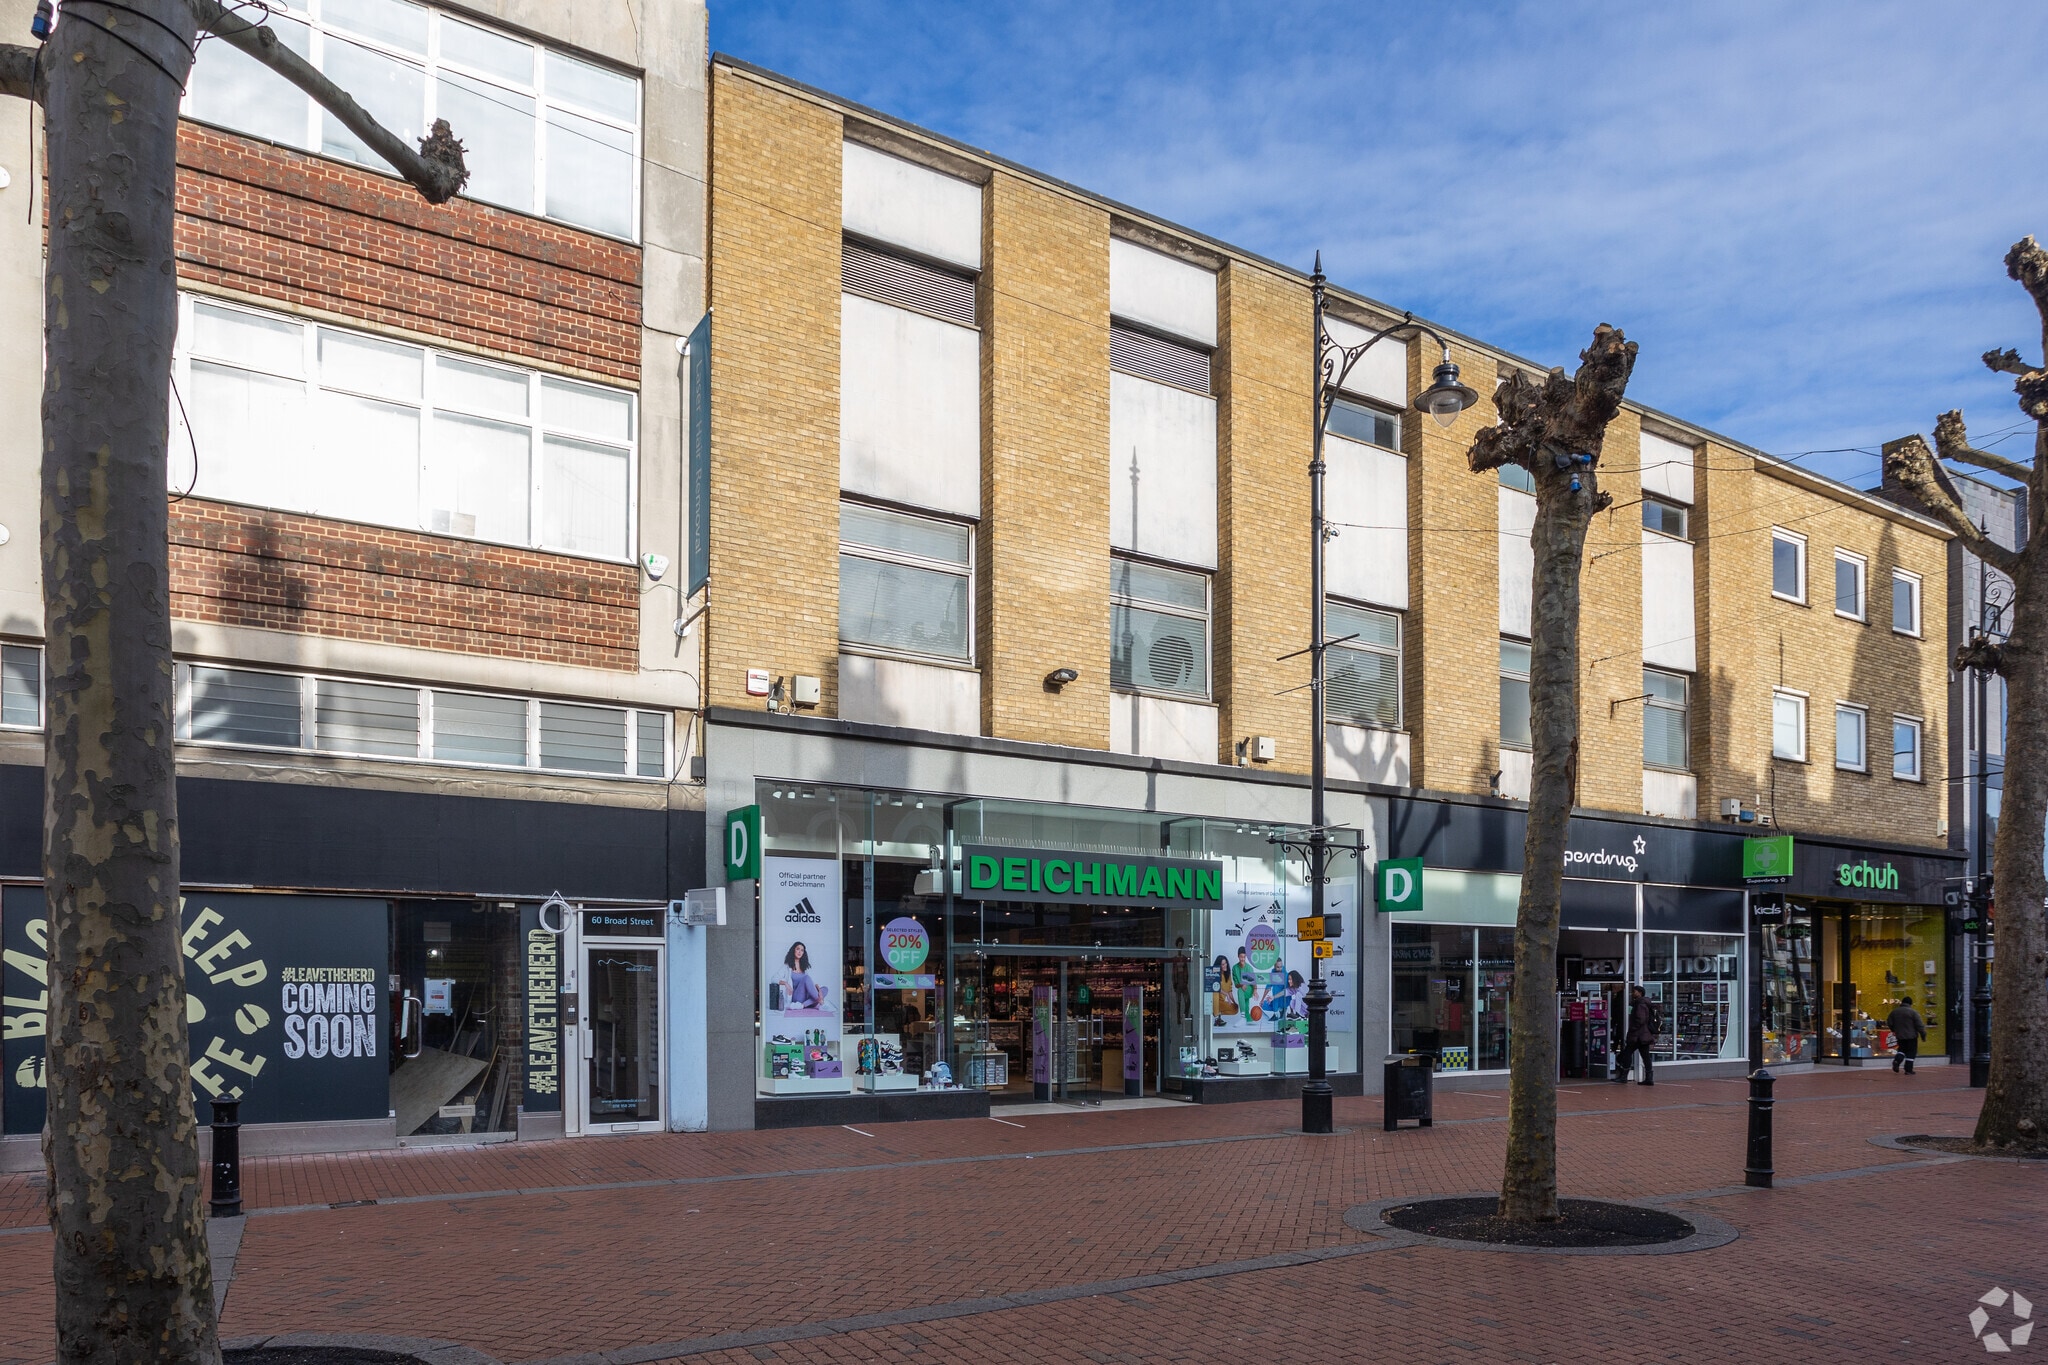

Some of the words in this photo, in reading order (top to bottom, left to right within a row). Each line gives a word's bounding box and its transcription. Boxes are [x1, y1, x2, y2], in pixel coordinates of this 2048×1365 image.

[695, 419, 703, 459] Hair
[731, 820, 748, 868] D
[1564, 848, 1639, 873] perdrug
[778, 871, 802, 880] Official
[802, 872, 826, 881] partner
[969, 855, 1222, 900] DEICHMANN
[1839, 860, 1899, 890] schuh
[788, 880, 826, 889] Deichmann
[1385, 867, 1413, 903] D
[1753, 903, 1782, 915] kids
[591, 916, 602, 925] 60
[604, 916, 628, 926] Broad
[630, 917, 654, 926] Street
[784, 912, 822, 923] adidas
[1306, 920, 1315, 929] NO
[887, 934, 923, 949] 20%
[1250, 938, 1275, 951] 20%
[887, 949, 921, 964] OFF
[1250, 951, 1274, 964] OFF
[281, 967, 375, 982] #LEAVETHEHERD
[282, 982, 376, 1014] COMING
[528, 928, 558, 1095] #LEAVETHEHERD
[283, 1014, 376, 1060] SOON
